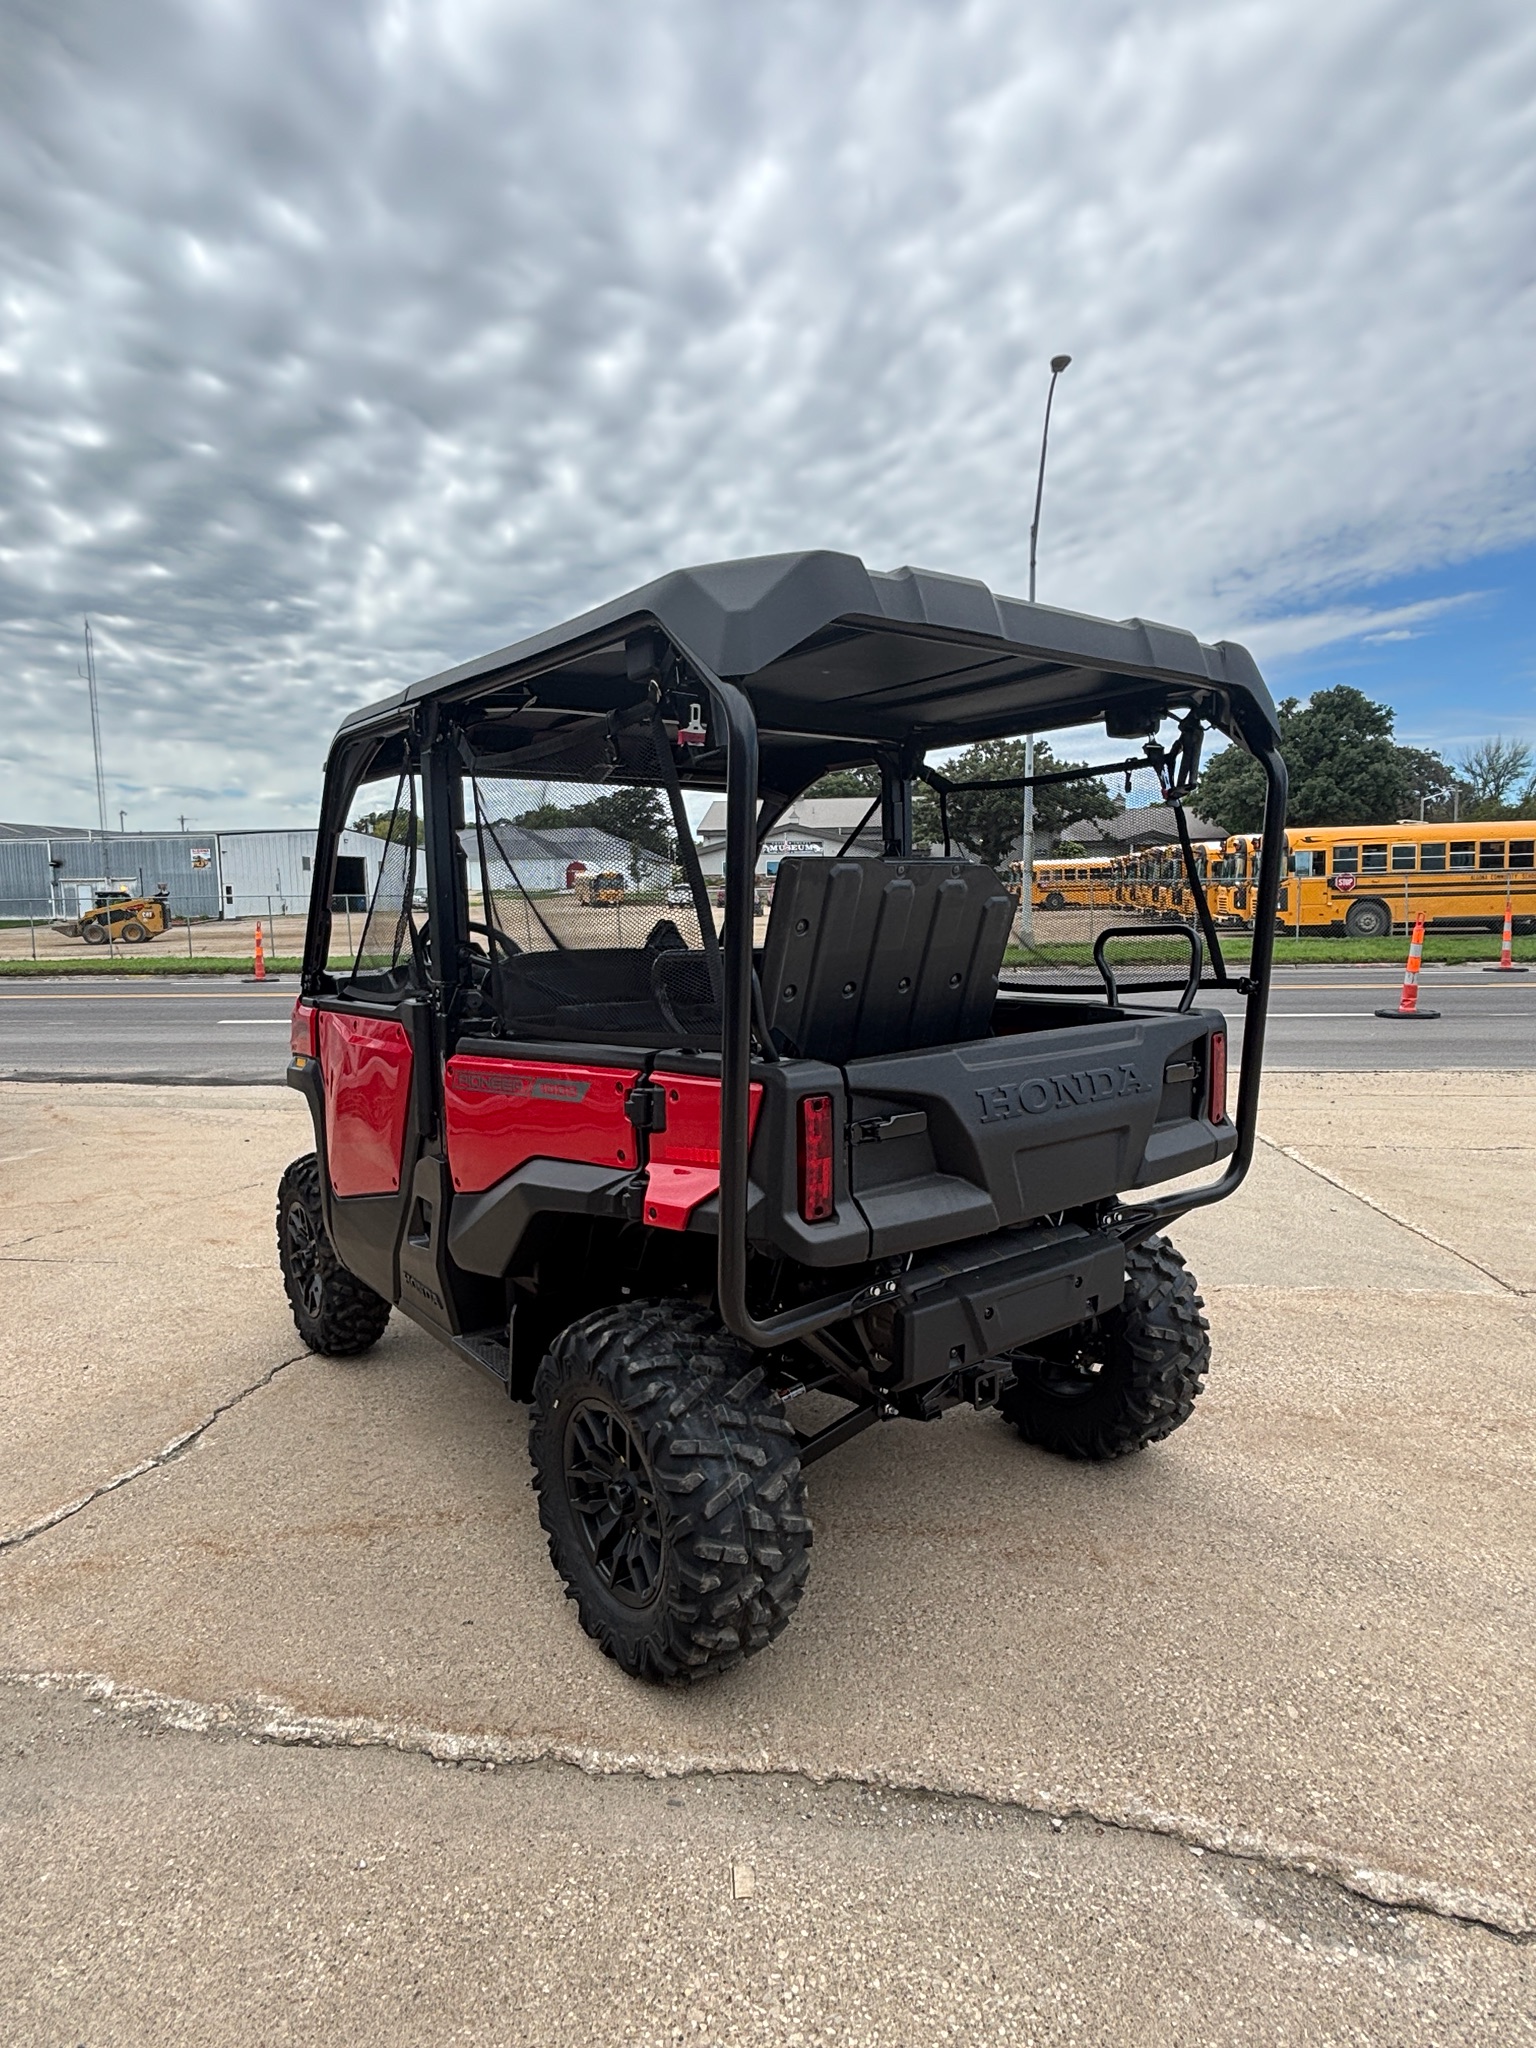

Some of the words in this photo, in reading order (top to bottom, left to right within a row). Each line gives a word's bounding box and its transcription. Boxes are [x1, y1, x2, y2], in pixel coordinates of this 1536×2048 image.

[769, 843, 814, 852] MUSEUM
[1338, 878, 1353, 886] STOP
[457, 1073, 524, 1093] PIONEER
[974, 1062, 1152, 1124] HONDA
[403, 1270, 443, 1309] HONDA
